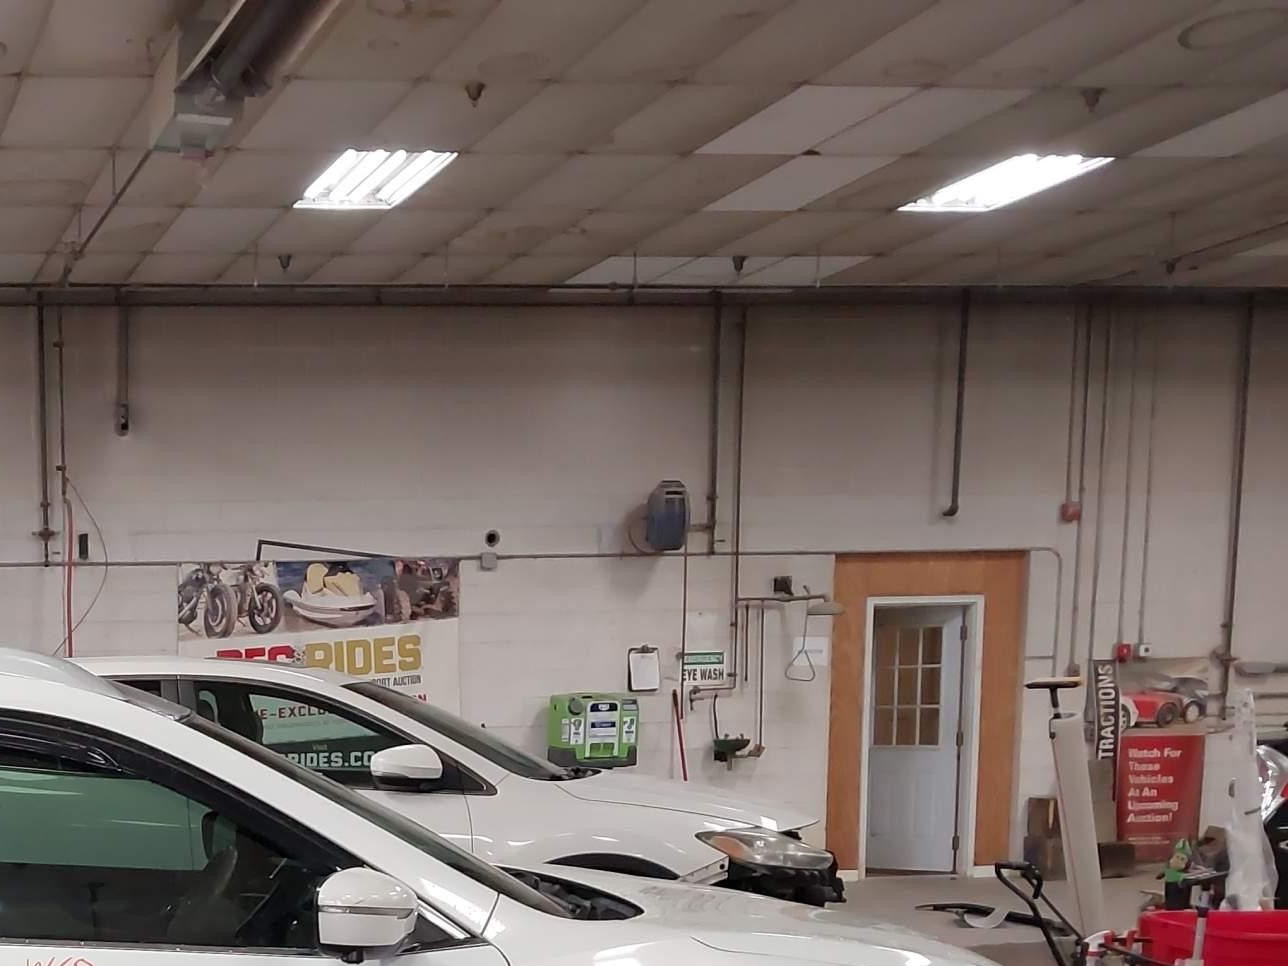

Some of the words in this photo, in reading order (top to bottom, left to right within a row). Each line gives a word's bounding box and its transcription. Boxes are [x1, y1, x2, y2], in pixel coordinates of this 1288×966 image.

[305, 634, 422, 676] RIDES
[683, 668, 698, 681] EYE
[699, 667, 724, 681] WASH
[392, 674, 422, 687] AUCTION
[1097, 664, 1115, 760] TRACTIONS
[1128, 747, 1161, 759] Watch
[1163, 747, 1182, 759] For
[1128, 760, 1161, 772] These
[1128, 773, 1174, 784] Vehicles
[1128, 787, 1140, 798] At
[1141, 787, 1158, 798] An
[1127, 812, 1173, 824] Auction!
